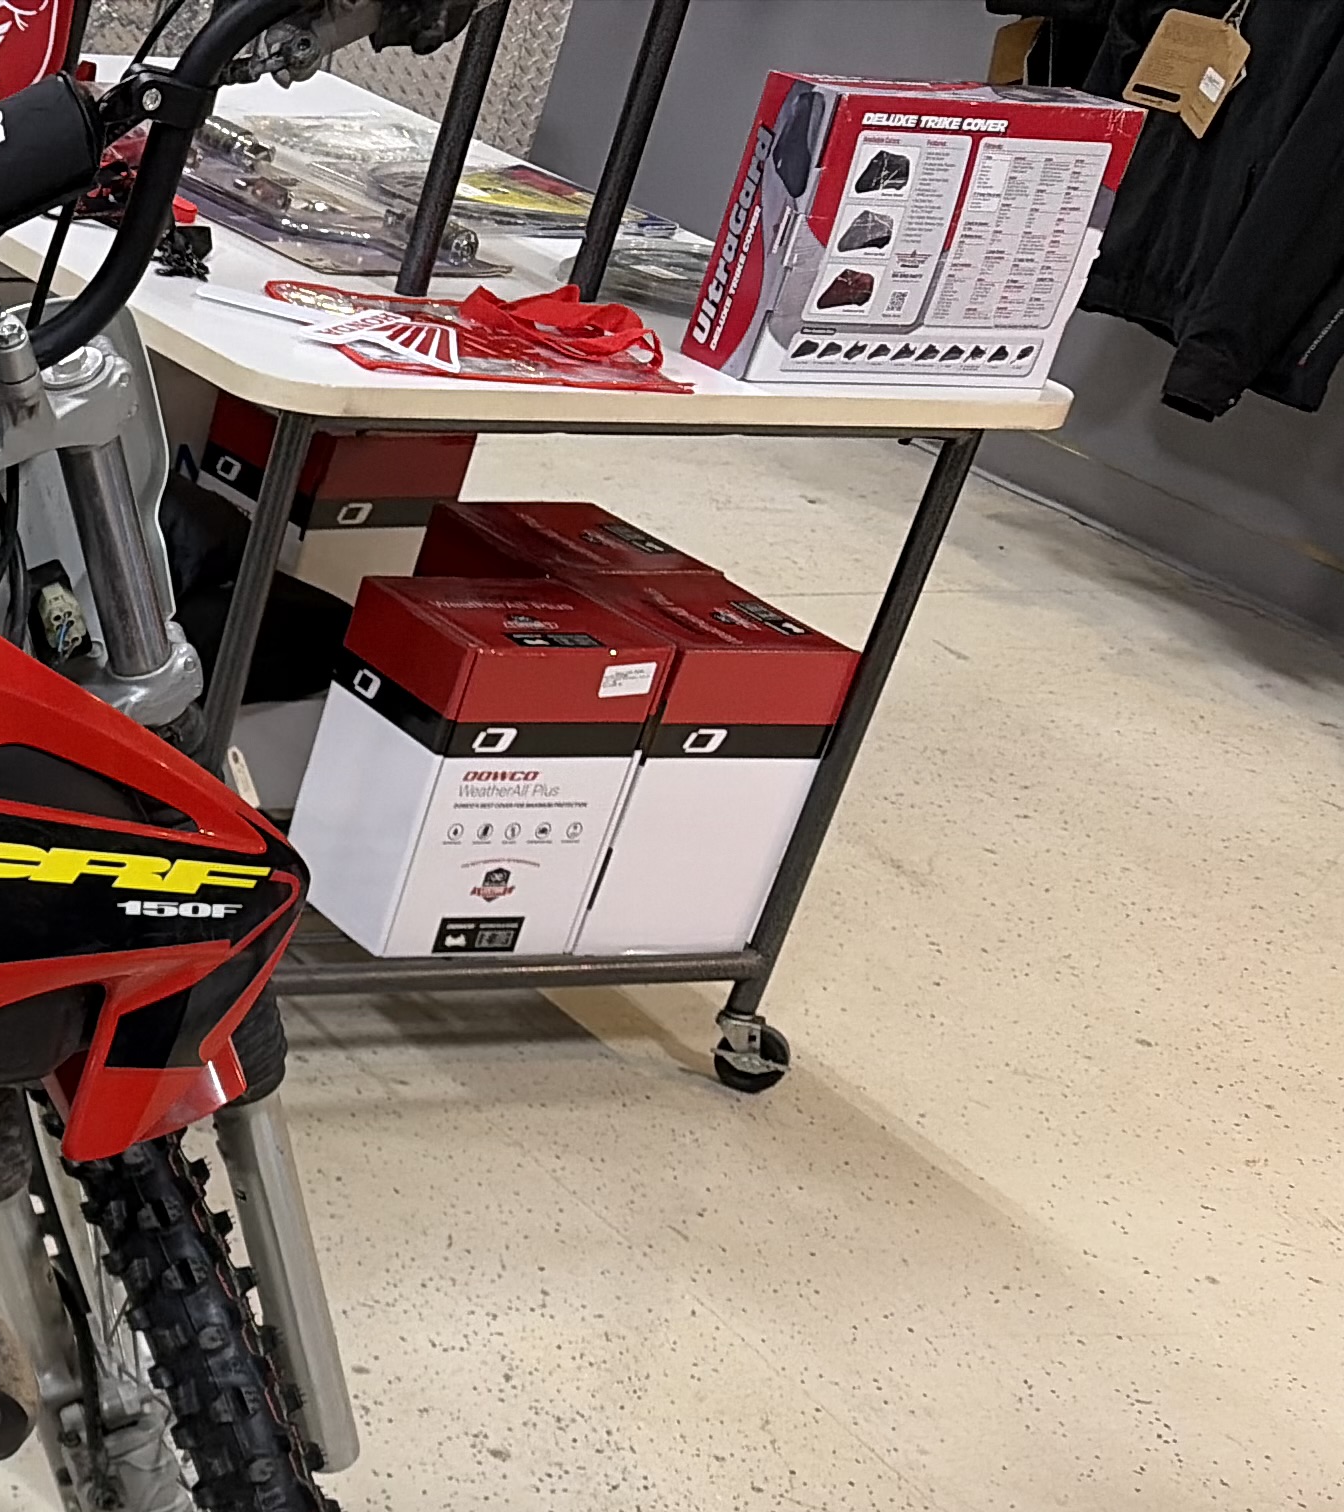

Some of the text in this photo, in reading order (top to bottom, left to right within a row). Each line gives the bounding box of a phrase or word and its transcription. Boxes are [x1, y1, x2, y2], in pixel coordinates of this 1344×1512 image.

[862, 112, 1009, 133] DELUXE TRIKE COVER
[691, 123, 776, 345] UltraGard
[709, 204, 763, 351] DELUXE TRIKE COVER
[462, 771, 541, 782] DOWCO
[532, 784, 560, 798] Plus
[117, 900, 244, 918] 150F
